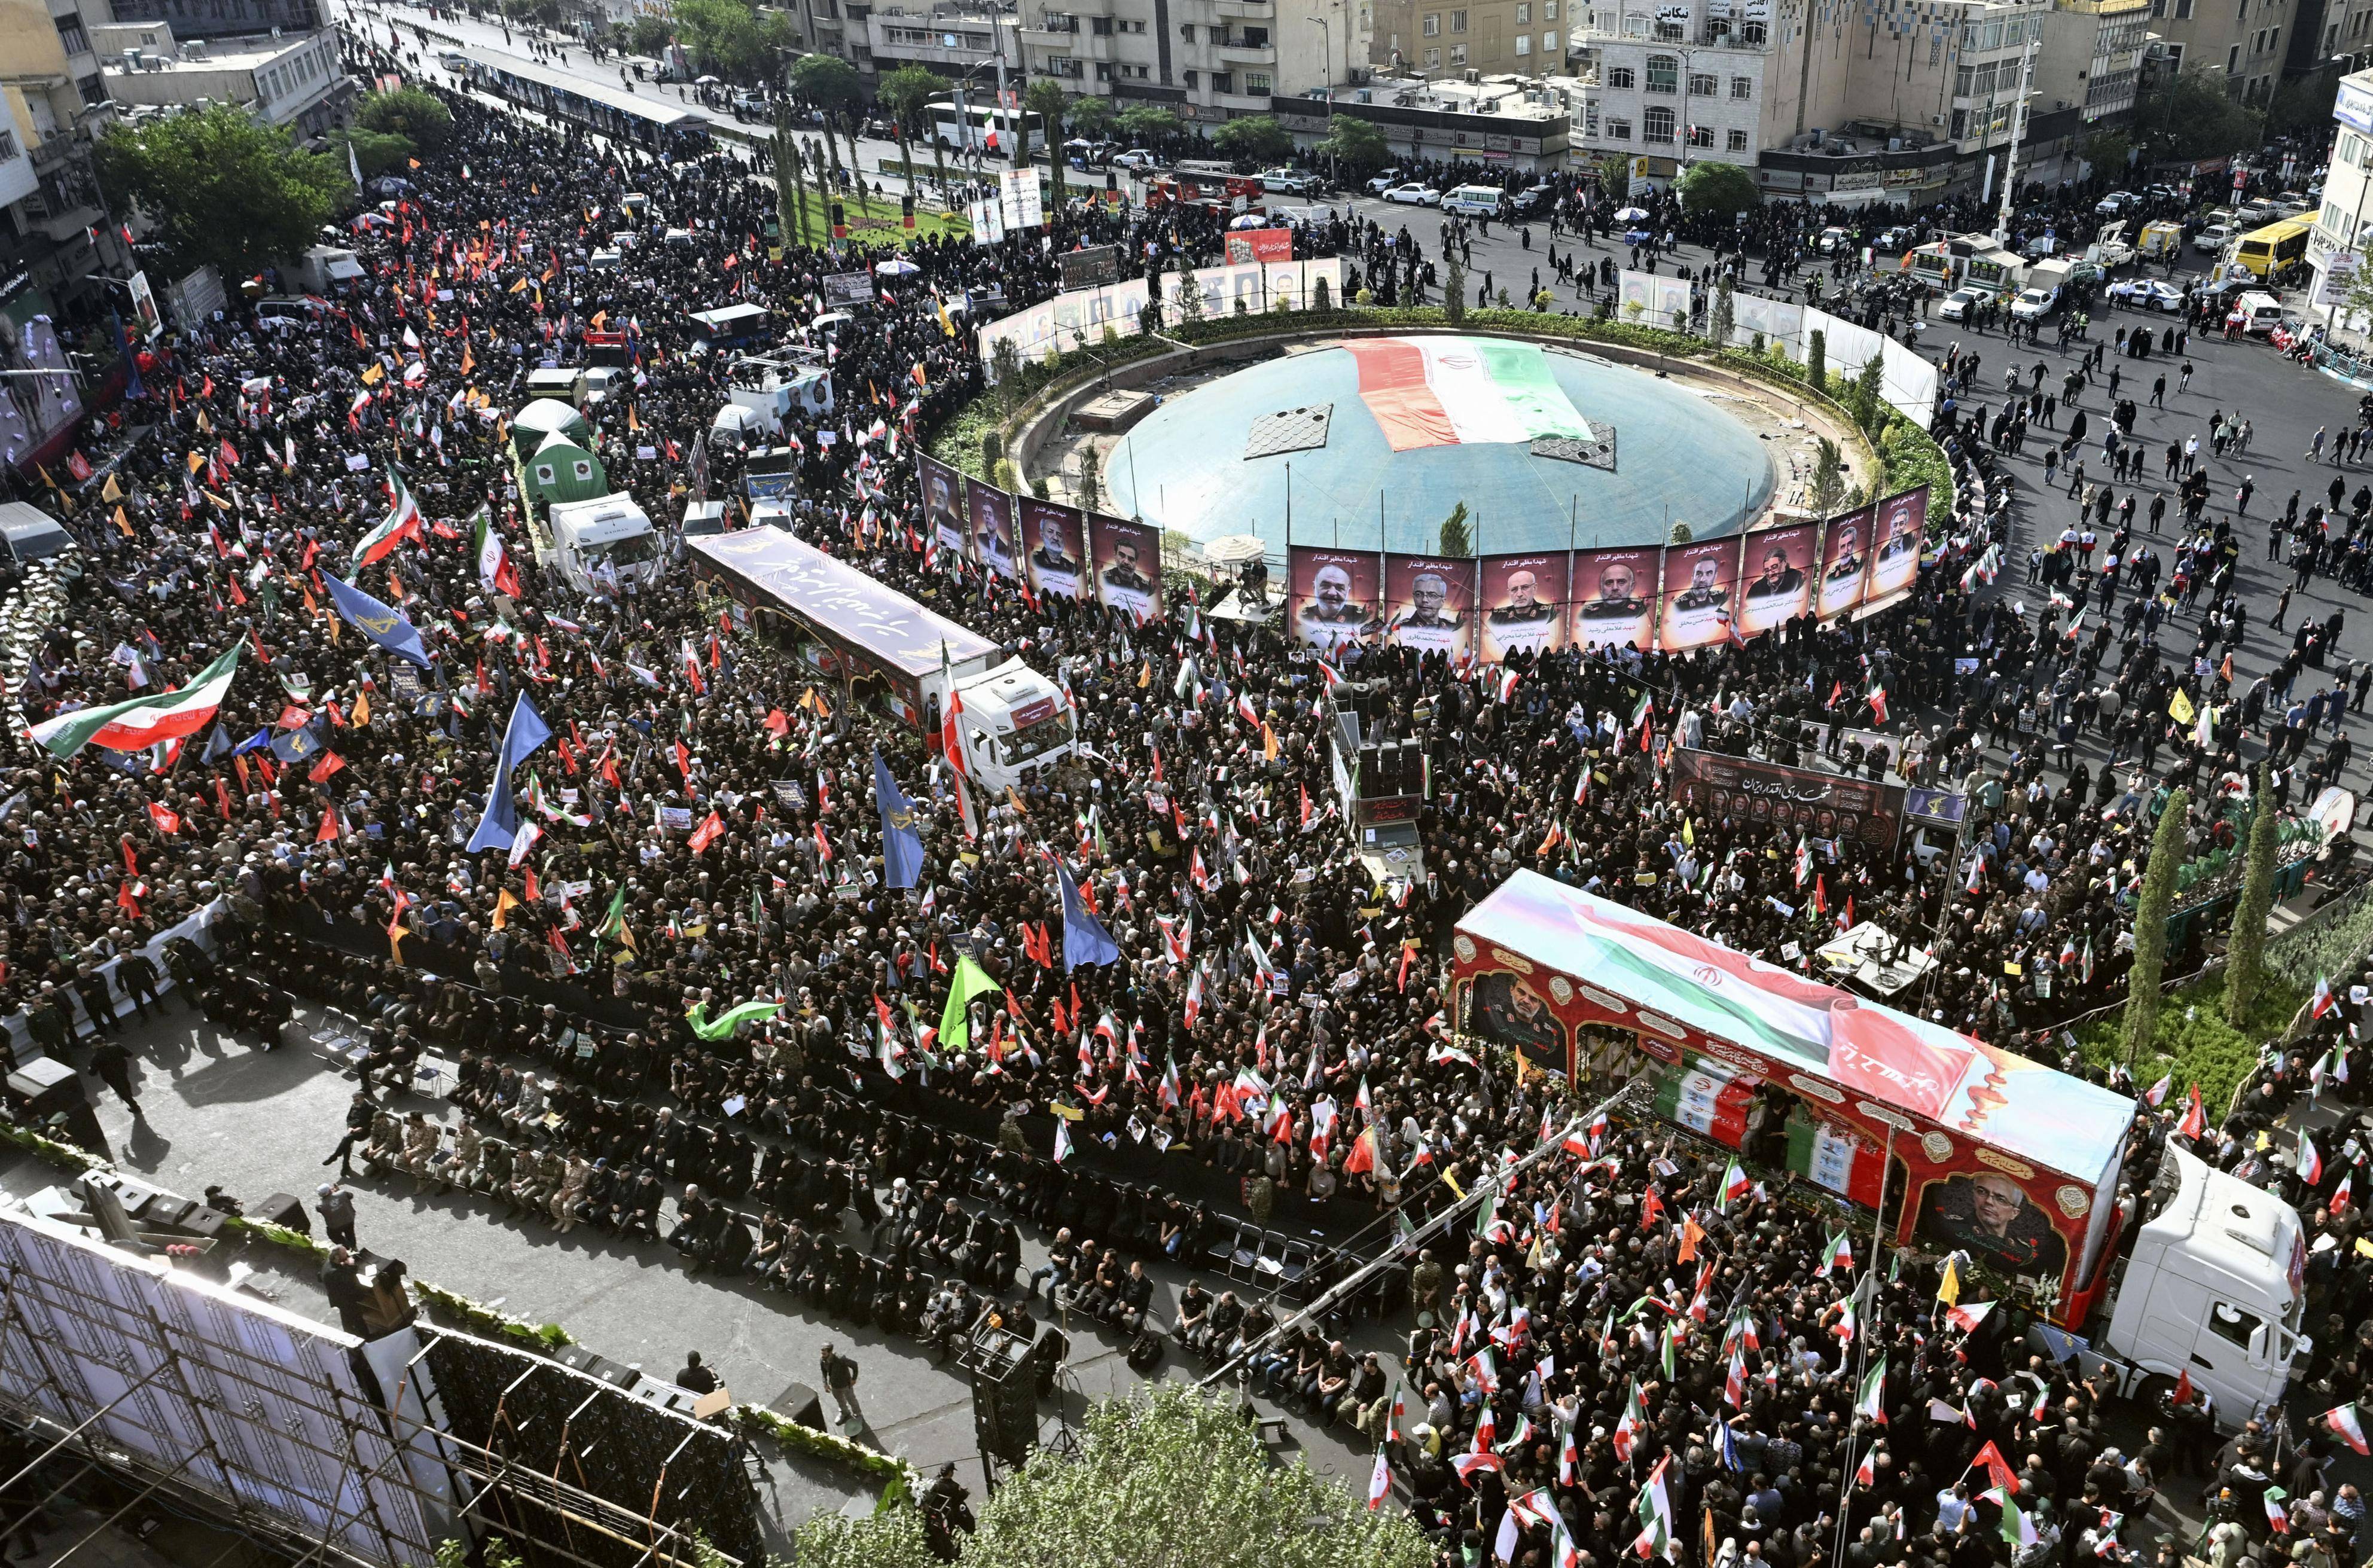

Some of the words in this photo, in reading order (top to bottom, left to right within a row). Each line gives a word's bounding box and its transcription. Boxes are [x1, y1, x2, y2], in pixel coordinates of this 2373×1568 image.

[1502, 560, 1519, 569] اقتدار
[1742, 777, 1764, 795] ایران
[1763, 780, 1782, 796] اقتدار
[1782, 783, 1831, 802] شهدای
[1861, 1053, 1939, 1096] حسین
